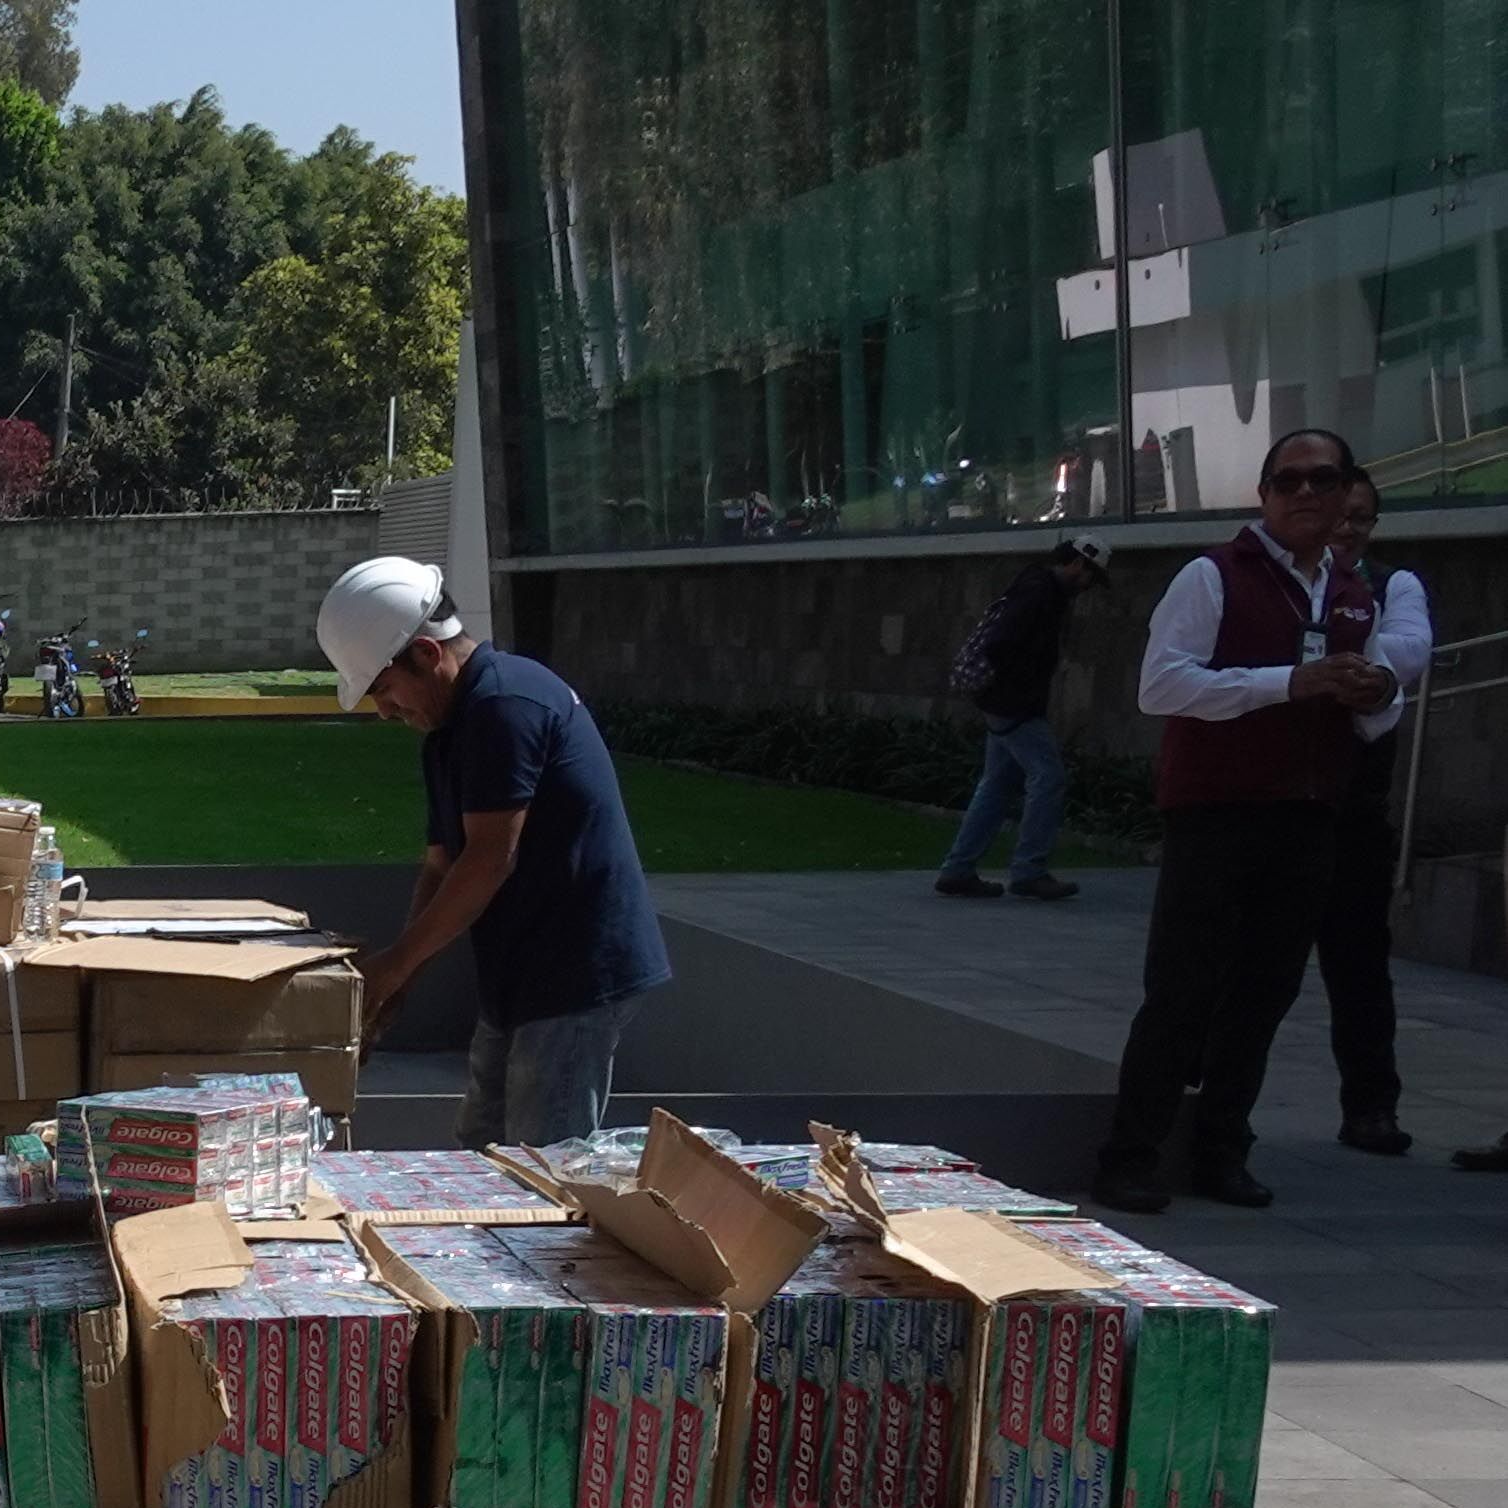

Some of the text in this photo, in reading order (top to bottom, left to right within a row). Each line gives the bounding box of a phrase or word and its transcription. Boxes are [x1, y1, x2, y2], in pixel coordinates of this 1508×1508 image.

[116, 1161, 191, 1179] Colgate
[117, 1127, 192, 1144] Colgate
[264, 1324, 283, 1441] Colgate
[304, 1322, 324, 1440] Colgate
[346, 1322, 365, 1440] Colgate
[1009, 1312, 1033, 1432] Colgate
[1053, 1312, 1076, 1432] Colgate
[1096, 1313, 1120, 1434] Colgate
[793, 1392, 815, 1508] Colgate
